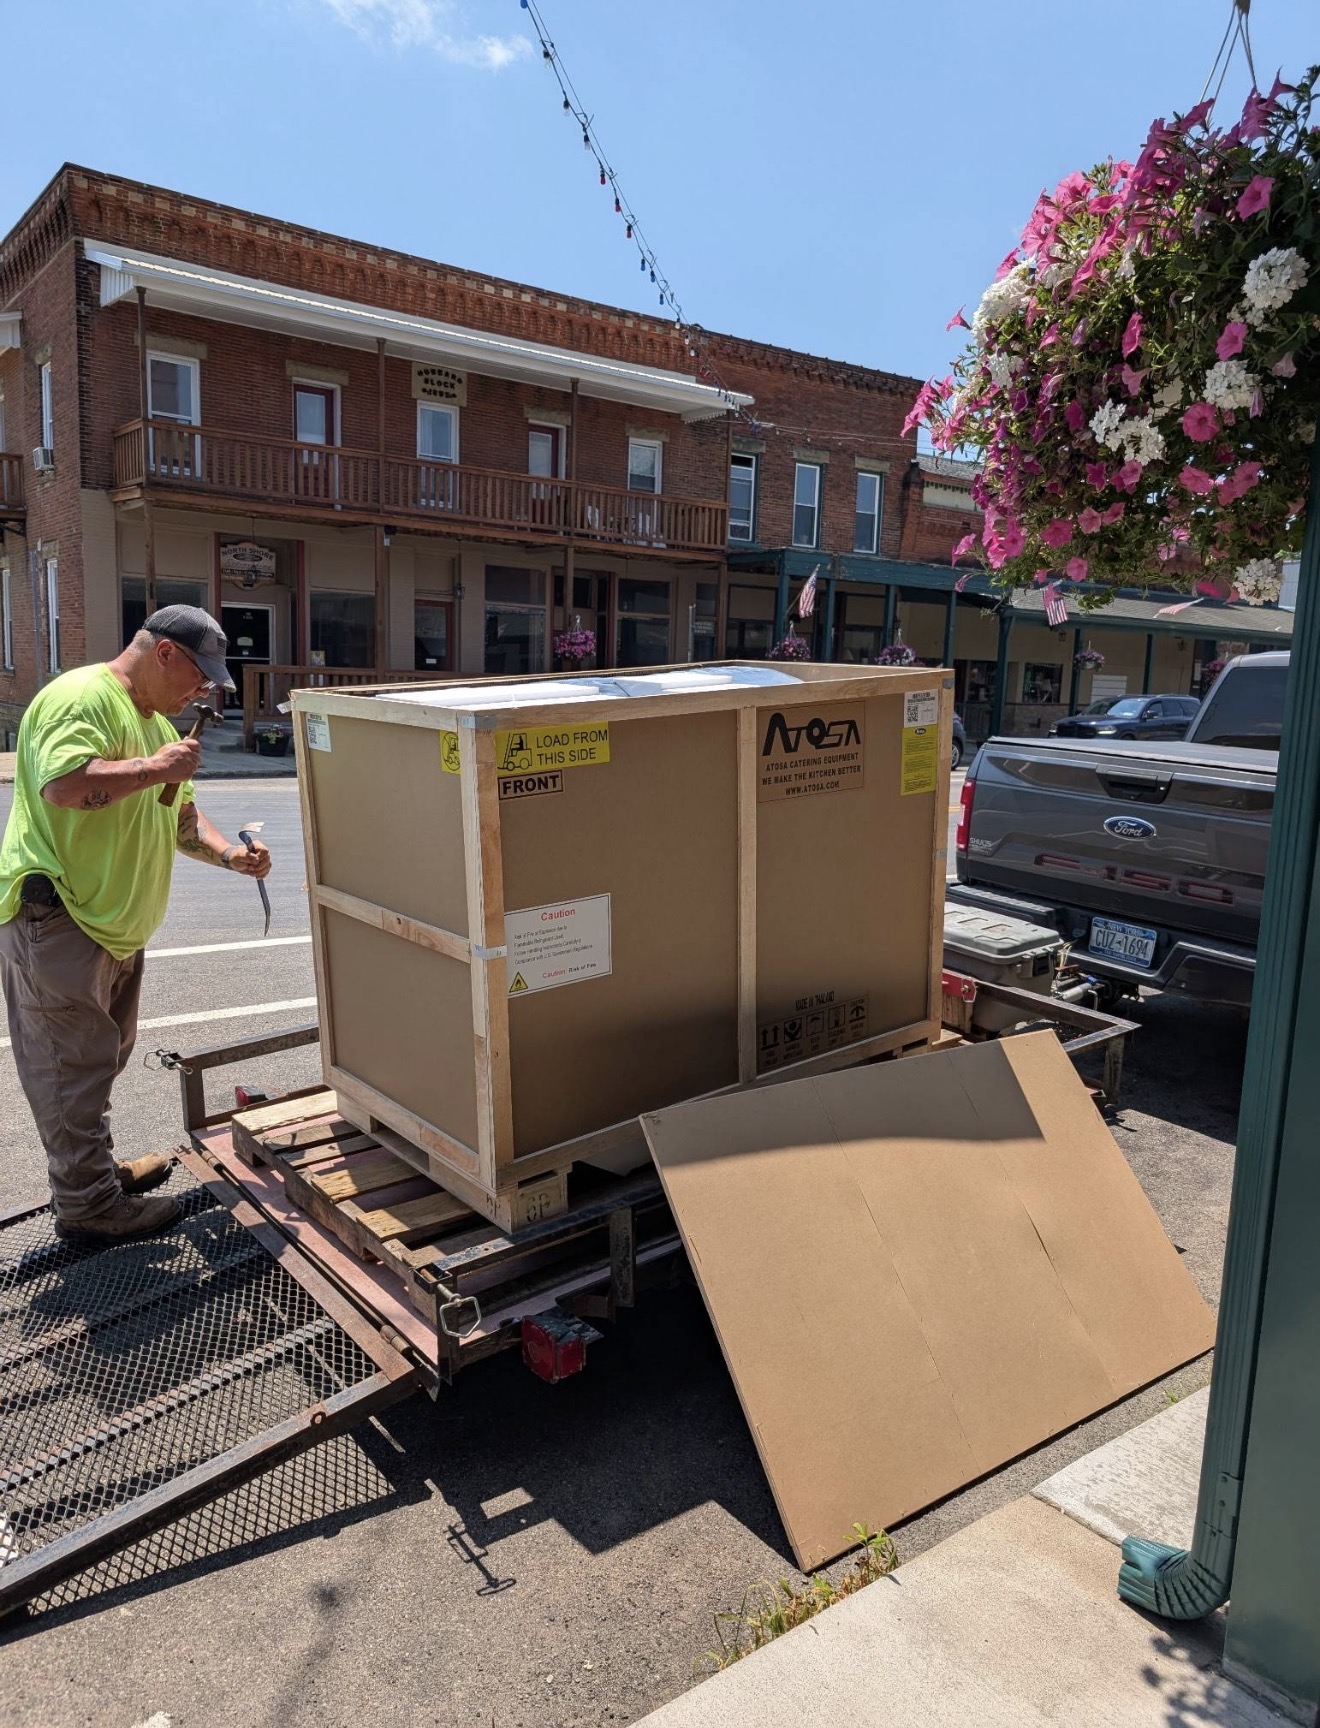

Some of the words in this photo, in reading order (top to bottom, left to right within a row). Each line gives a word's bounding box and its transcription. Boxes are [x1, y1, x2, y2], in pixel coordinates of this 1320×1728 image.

[417, 368, 463, 384] HUBBARD
[424, 378, 456, 390] BLOCK
[221, 547, 247, 556] NORTH
[248, 547, 275, 561] SHORE
[536, 733, 570, 749] LOAD
[573, 729, 609, 744] FROM
[762, 712, 861, 756] ATOSA
[536, 751, 566, 766] THIS
[569, 748, 597, 762] SIDE
[765, 760, 788, 772] ATOSA
[789, 756, 822, 769] CATERING
[823, 752, 859, 765] EQUIPMENT
[502, 774, 560, 795] FRONT
[762, 777, 772, 786] WE
[774, 774, 792, 784] MAKE
[794, 772, 807, 781] THE
[808, 769, 836, 780] KITCHEN
[837, 765, 861, 776] BETTER
[785, 780, 840, 796] WWW.ATOSA.COM
[1114, 820, 1144, 837] Ford
[541, 908, 576, 921] Caution
[1107, 922, 1122, 932] NEW
[1124, 925, 1143, 937] YORK
[1095, 929, 1116, 950] CUZ
[1123, 935, 1149, 958] 1694
[795, 998, 808, 1012] MADE
[808, 996, 814, 1008] IN
[814, 990, 835, 1006] THAILAND
